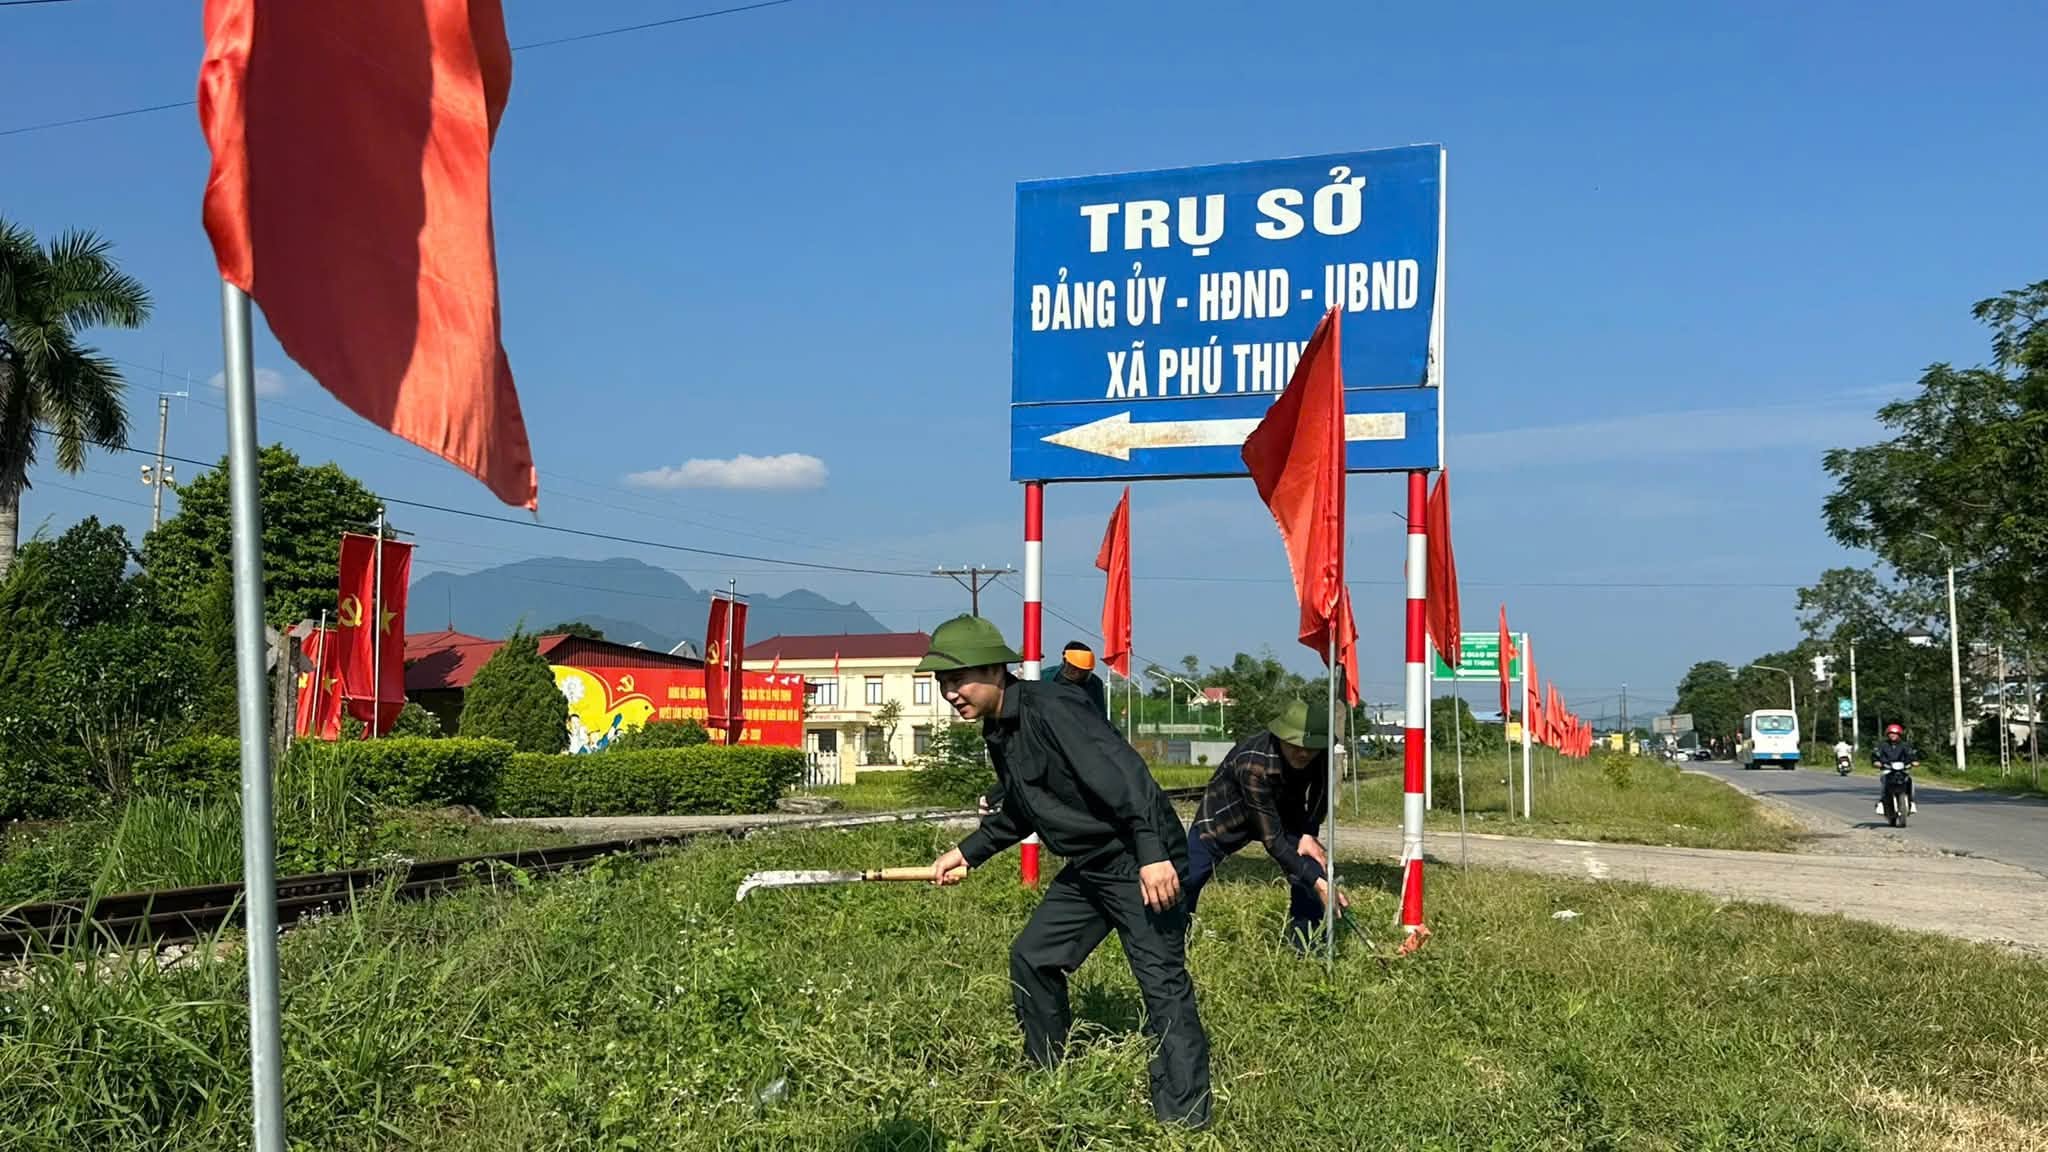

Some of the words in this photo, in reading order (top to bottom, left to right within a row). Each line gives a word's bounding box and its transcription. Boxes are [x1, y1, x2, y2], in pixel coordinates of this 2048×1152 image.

[1080, 193, 1225, 257] TRỤ
[1255, 165, 1367, 240] SỞ
[1030, 267, 1116, 332] ĐẢNG
[1126, 261, 1167, 326] ỦY
[1199, 268, 1290, 323] HĐND
[1324, 258, 1420, 314] UBND
[1105, 339, 1148, 399] XÃ
[1158, 335, 1223, 398] PHÚ
